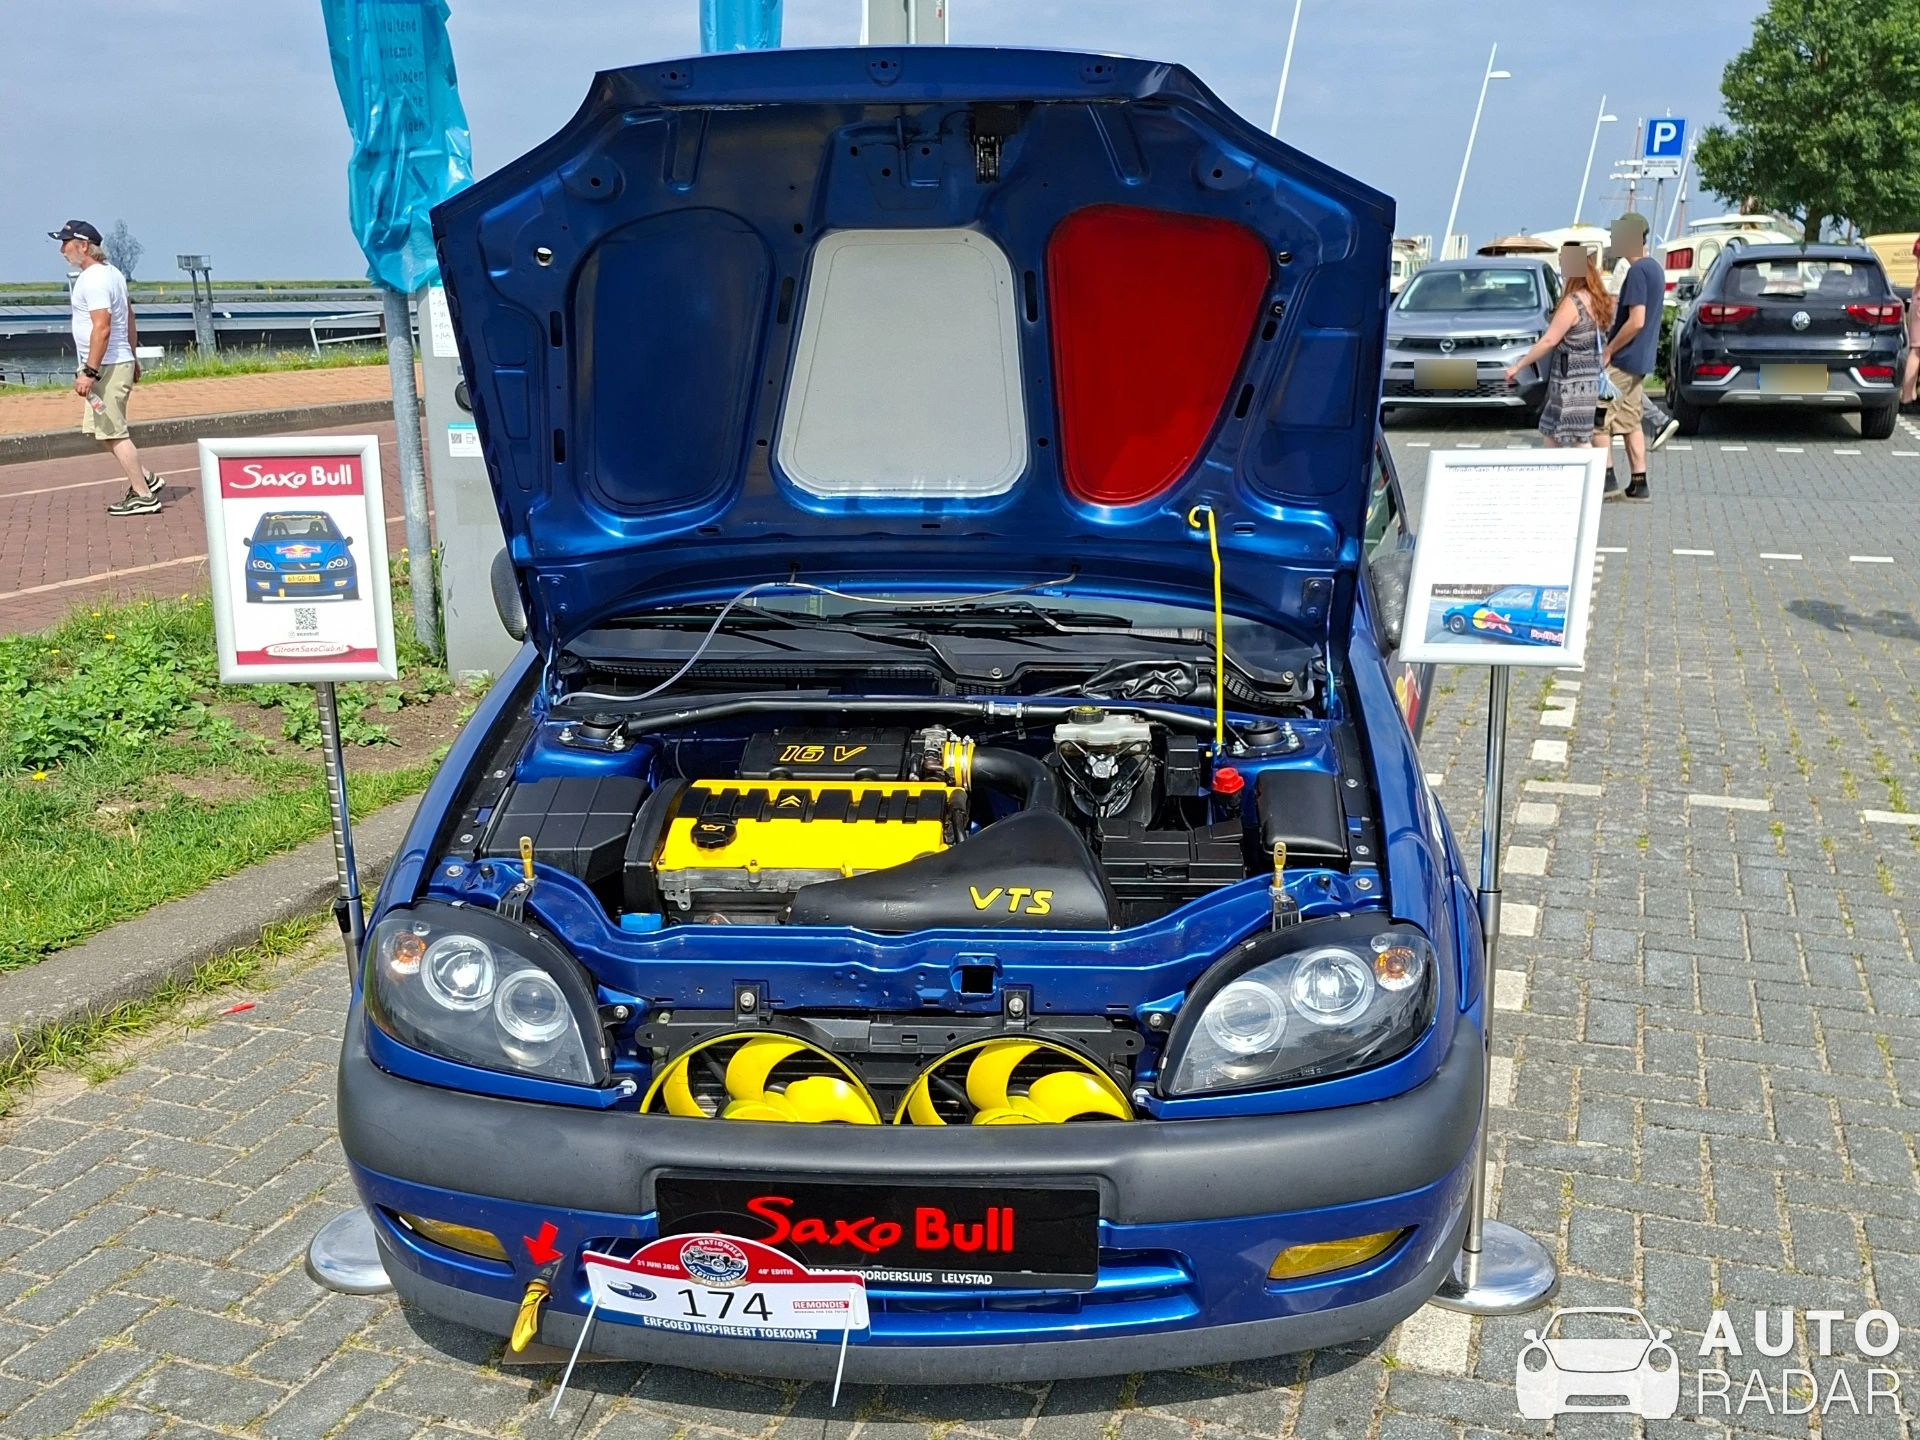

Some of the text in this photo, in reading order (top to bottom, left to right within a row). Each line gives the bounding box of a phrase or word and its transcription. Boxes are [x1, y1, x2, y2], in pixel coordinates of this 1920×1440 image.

[1653, 122, 1677, 153] P
[229, 464, 353, 489] Saxo Bull
[968, 886, 1054, 916] VTS
[747, 1196, 1013, 1252] Saxo Bull
[941, 1273, 993, 1285] LELYSTAD
[678, 1288, 773, 1321] 174
[643, 1315, 818, 1340] ERFGOED INSPIREERT TOEKOMST
